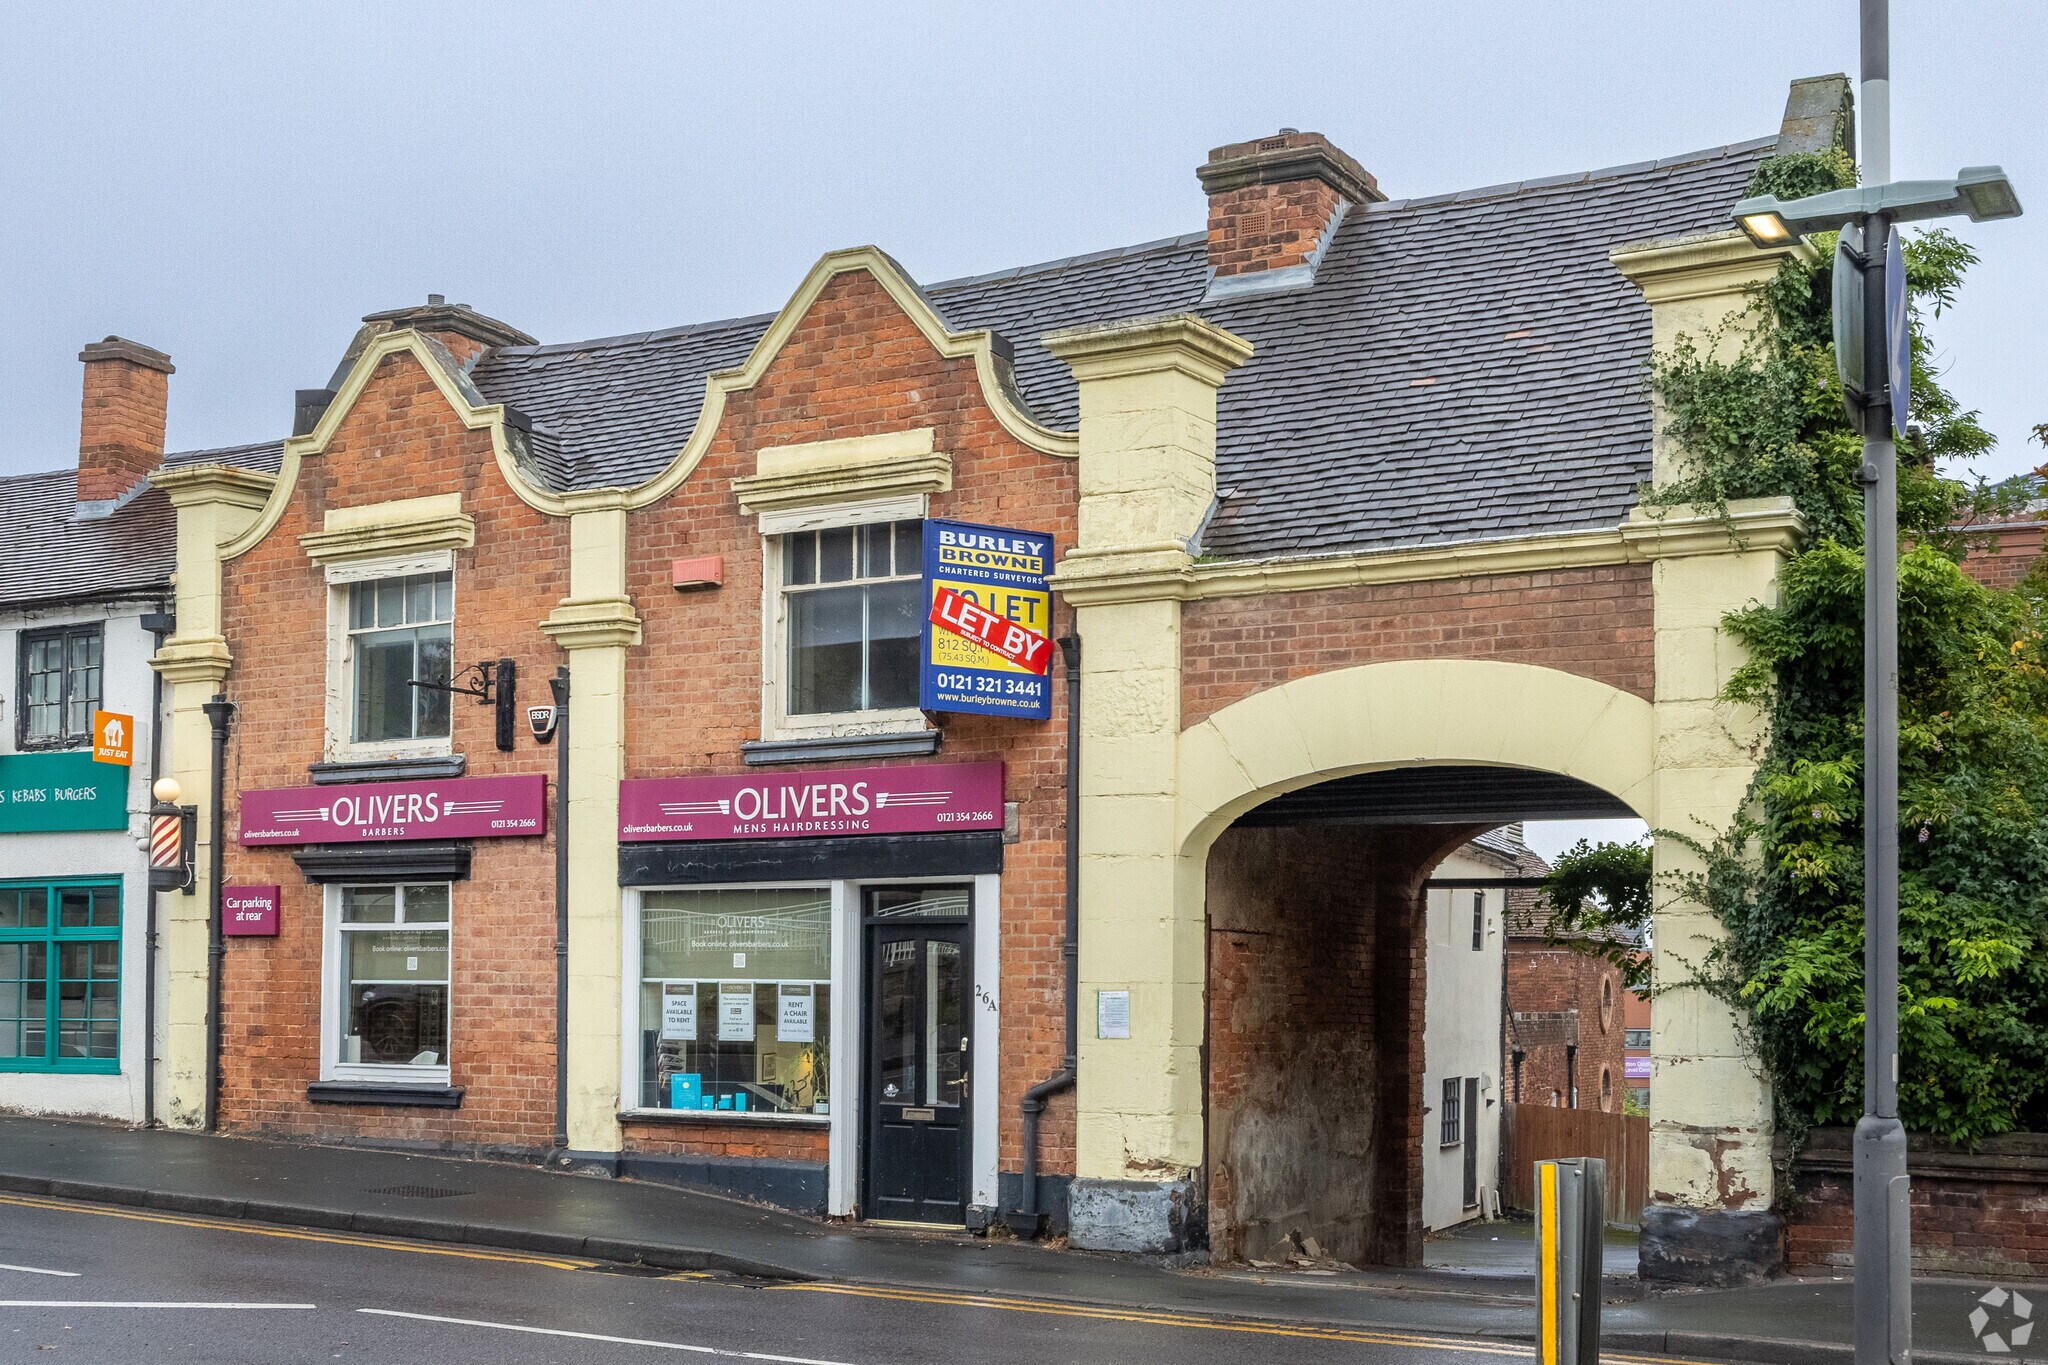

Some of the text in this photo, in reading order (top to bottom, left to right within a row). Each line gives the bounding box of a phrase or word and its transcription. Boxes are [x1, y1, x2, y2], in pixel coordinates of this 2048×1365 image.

[939, 530, 1044, 556] BURLEY
[942, 548, 1041, 571] BROWNE
[938, 565, 1043, 585] CHARTERED SURVEYORS
[940, 594, 1044, 662] LET BY
[938, 637, 959, 651] 812
[960, 628, 1016, 660] SUBJECT TO CONTRACT
[938, 651, 990, 667] (75.43 SQ.M.)
[937, 672, 1041, 697] 0121 321 3441
[937, 692, 1041, 709] www.burleybrowne.co.uk
[98, 747, 128, 759] JUST EAT
[12, 788, 47, 803] KEBABS
[54, 786, 97, 801] BURGERS
[734, 781, 870, 821] OLIVERS
[332, 792, 439, 826] OLIVERS
[937, 811, 993, 822] 0121 354 2666
[491, 818, 536, 829] 0121 354 2666
[623, 822, 693, 834] oliversbarbers.co.uk
[733, 819, 870, 834] MENS HAIRDRESSING
[244, 828, 300, 839] oliversbarbers.co.uk
[362, 826, 405, 837] BARBERS
[226, 896, 272, 911] Car parking
[236, 911, 262, 921] at rear
[717, 915, 765, 928] OLIVERS
[691, 939, 789, 948] Book online: oliversbarbers.co.uk
[976, 983, 998, 1012] 26A
